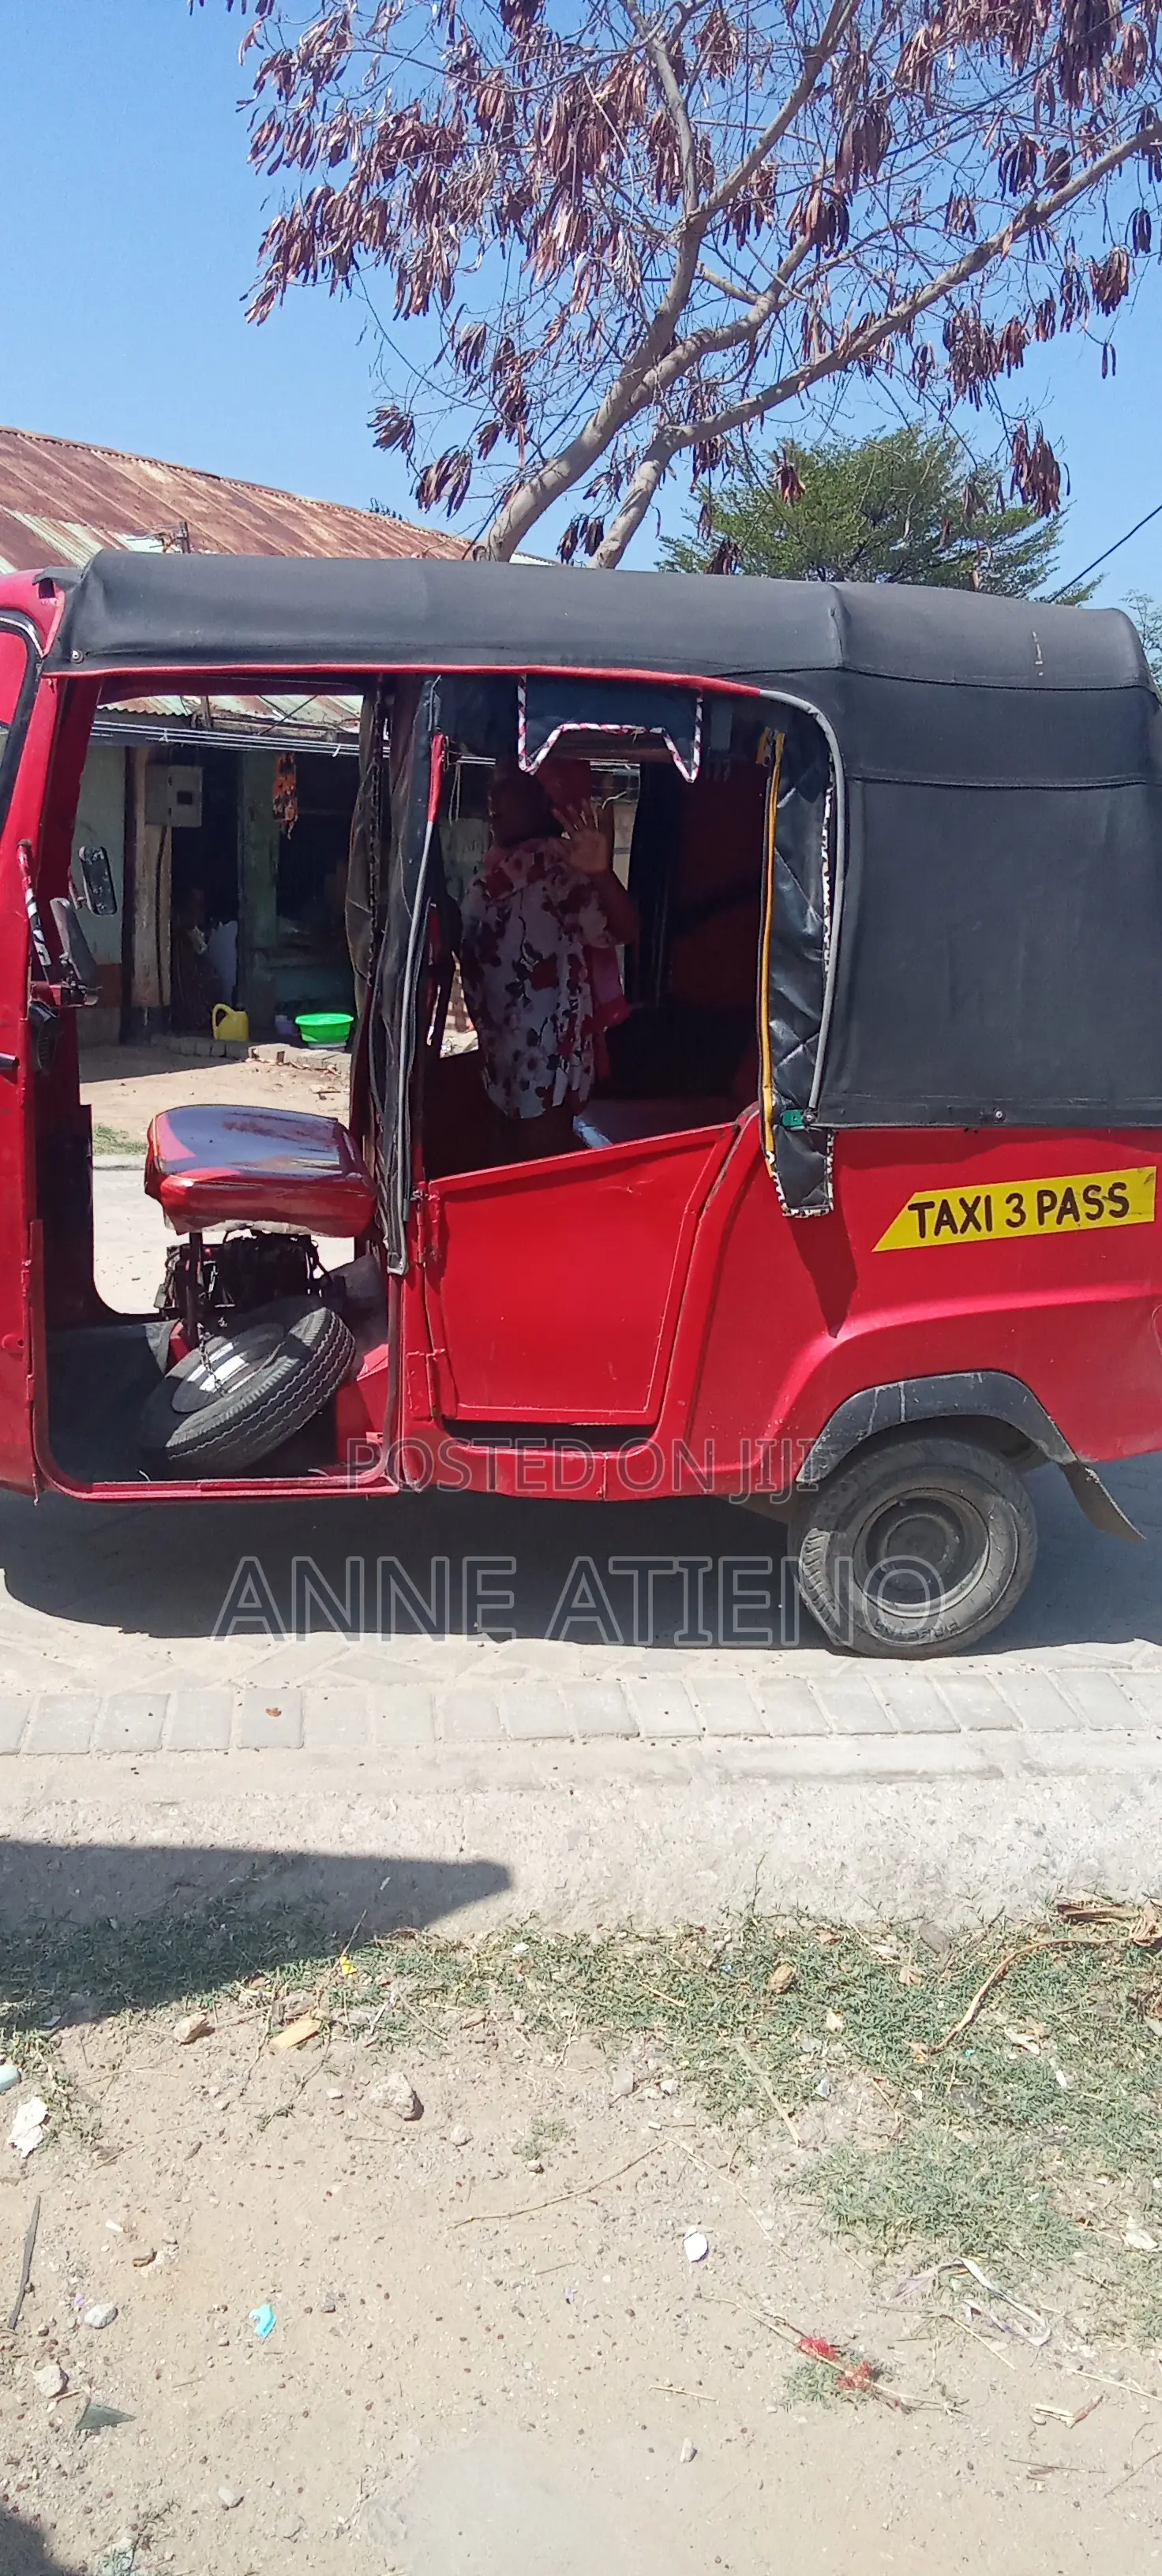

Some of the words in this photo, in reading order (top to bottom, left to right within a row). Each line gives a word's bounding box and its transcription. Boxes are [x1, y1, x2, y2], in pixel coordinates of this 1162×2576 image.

[908, 1195, 993, 1238] TAXI
[1005, 1193, 1027, 1228] 3
[1036, 1181, 1130, 1226] PASS
